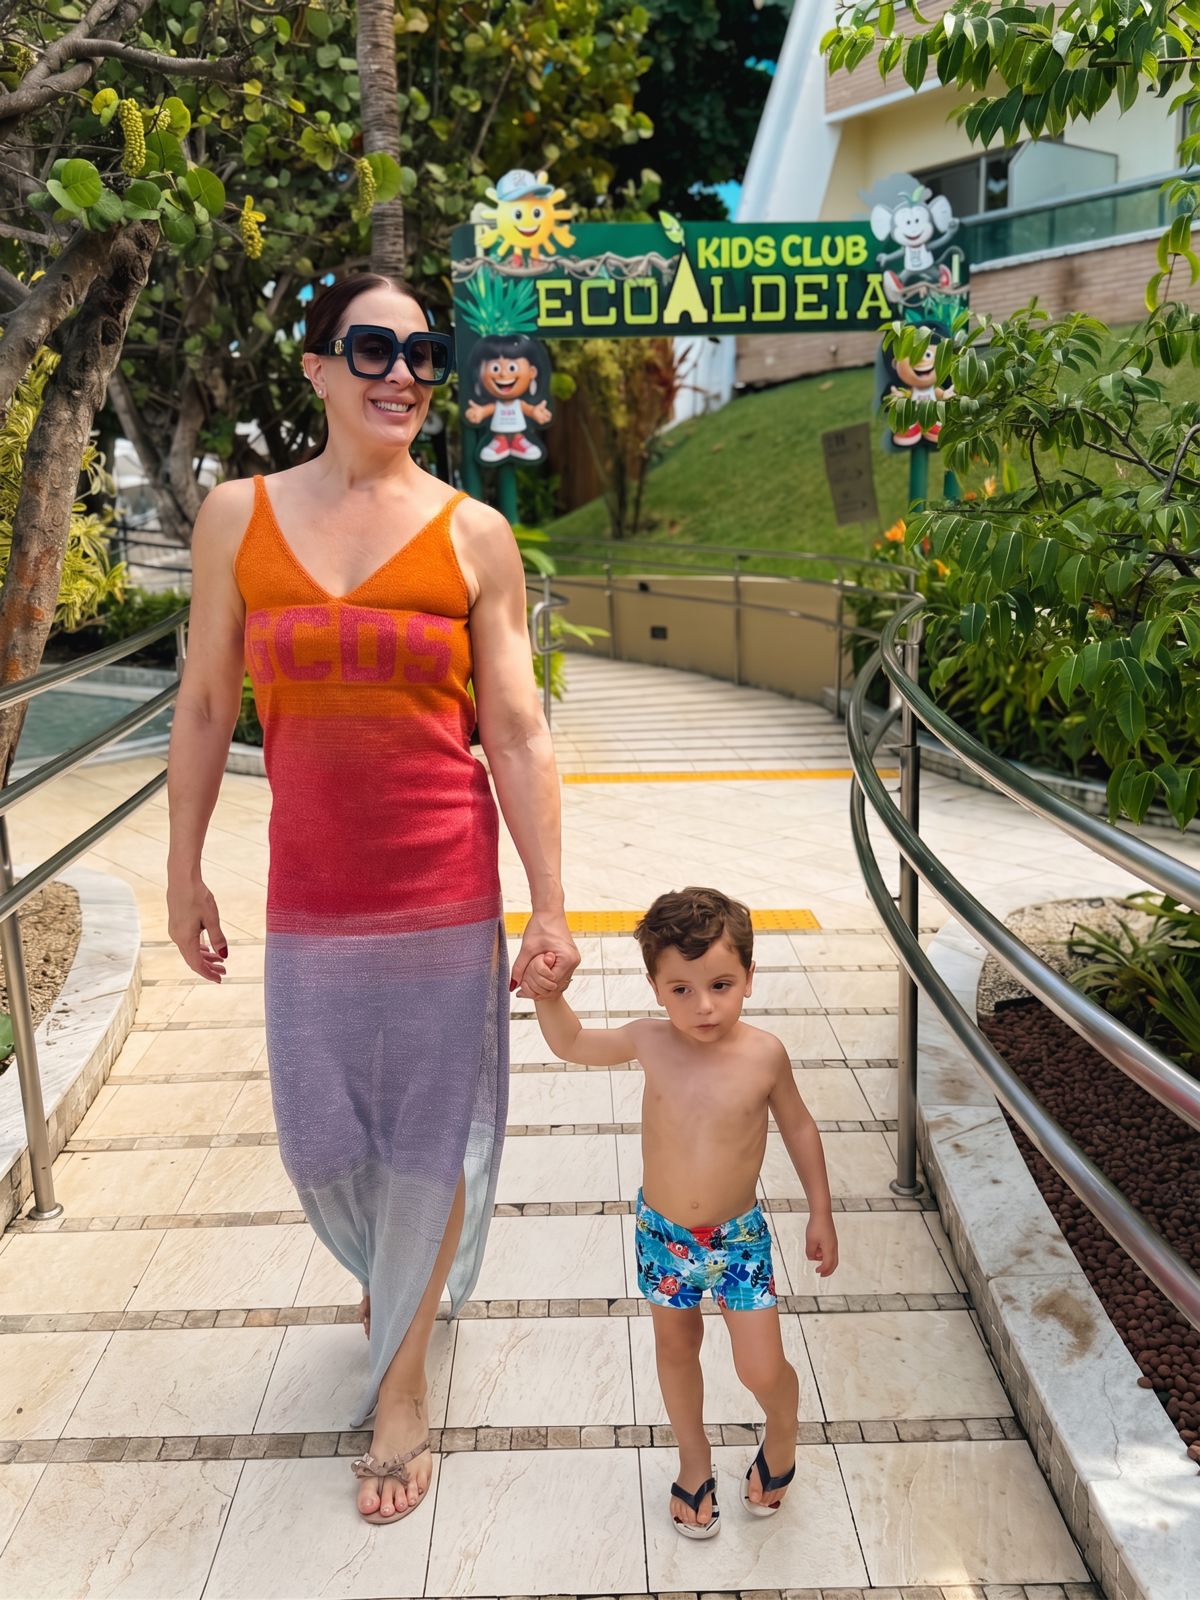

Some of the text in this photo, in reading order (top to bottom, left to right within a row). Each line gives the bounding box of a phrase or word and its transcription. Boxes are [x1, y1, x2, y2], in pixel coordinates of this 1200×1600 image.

[697, 234, 868, 269] KIDS CLUB
[536, 252, 893, 327] ECOALDEIA
[246, 606, 453, 685] GCDS
